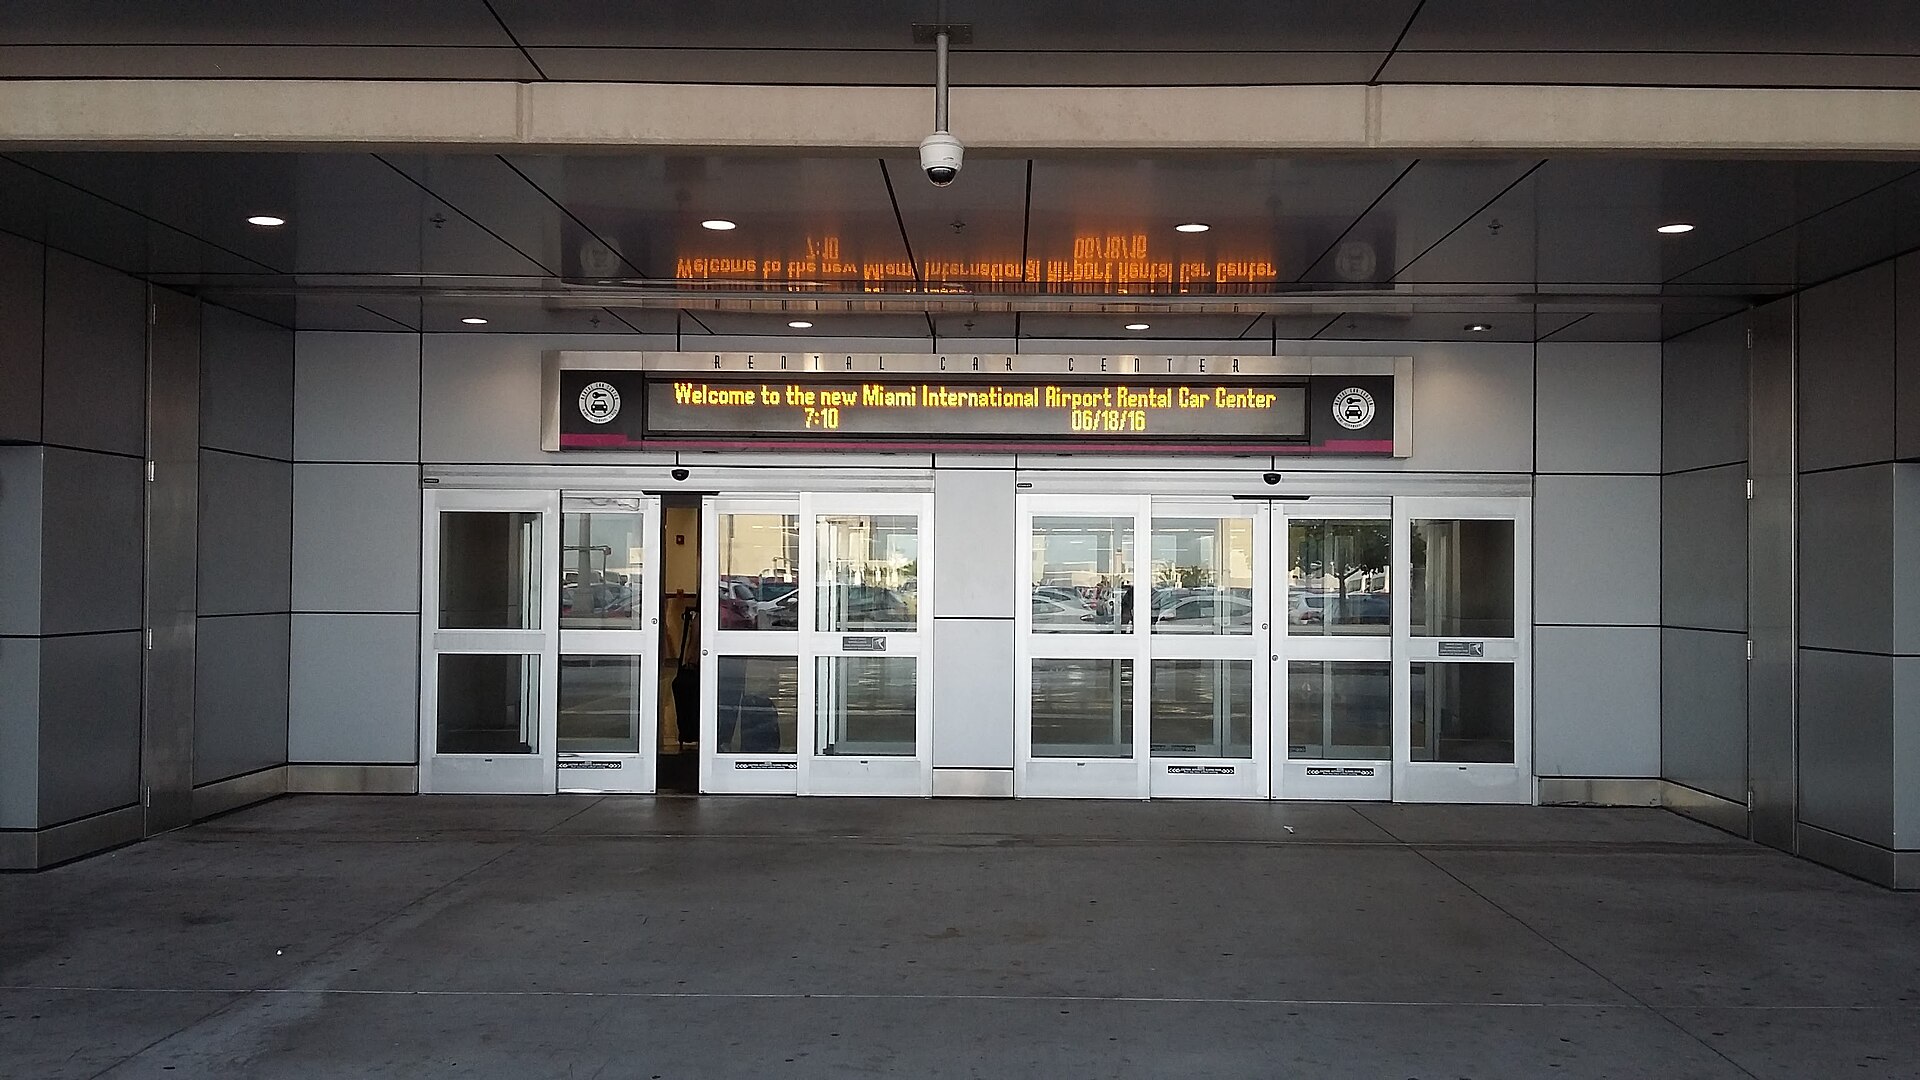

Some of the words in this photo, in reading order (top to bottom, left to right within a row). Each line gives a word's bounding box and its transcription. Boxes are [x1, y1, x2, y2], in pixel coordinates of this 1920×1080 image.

[714, 355, 884, 370] RENTAL
[940, 356, 1012, 372] CAR
[1068, 357, 1240, 373] CENTER
[674, 383, 755, 405] Welcome
[761, 385, 780, 405] to
[786, 385, 816, 405] the
[821, 391, 858, 406] new
[862, 385, 916, 406] Miami
[922, 385, 1038, 407] International
[1045, 386, 1112, 410] Airport
[1117, 387, 1172, 408] Rental
[1178, 387, 1210, 408] Car
[1215, 387, 1277, 408] Center
[804, 407, 838, 429] 7:10
[1071, 410, 1146, 431] 06/18/16
